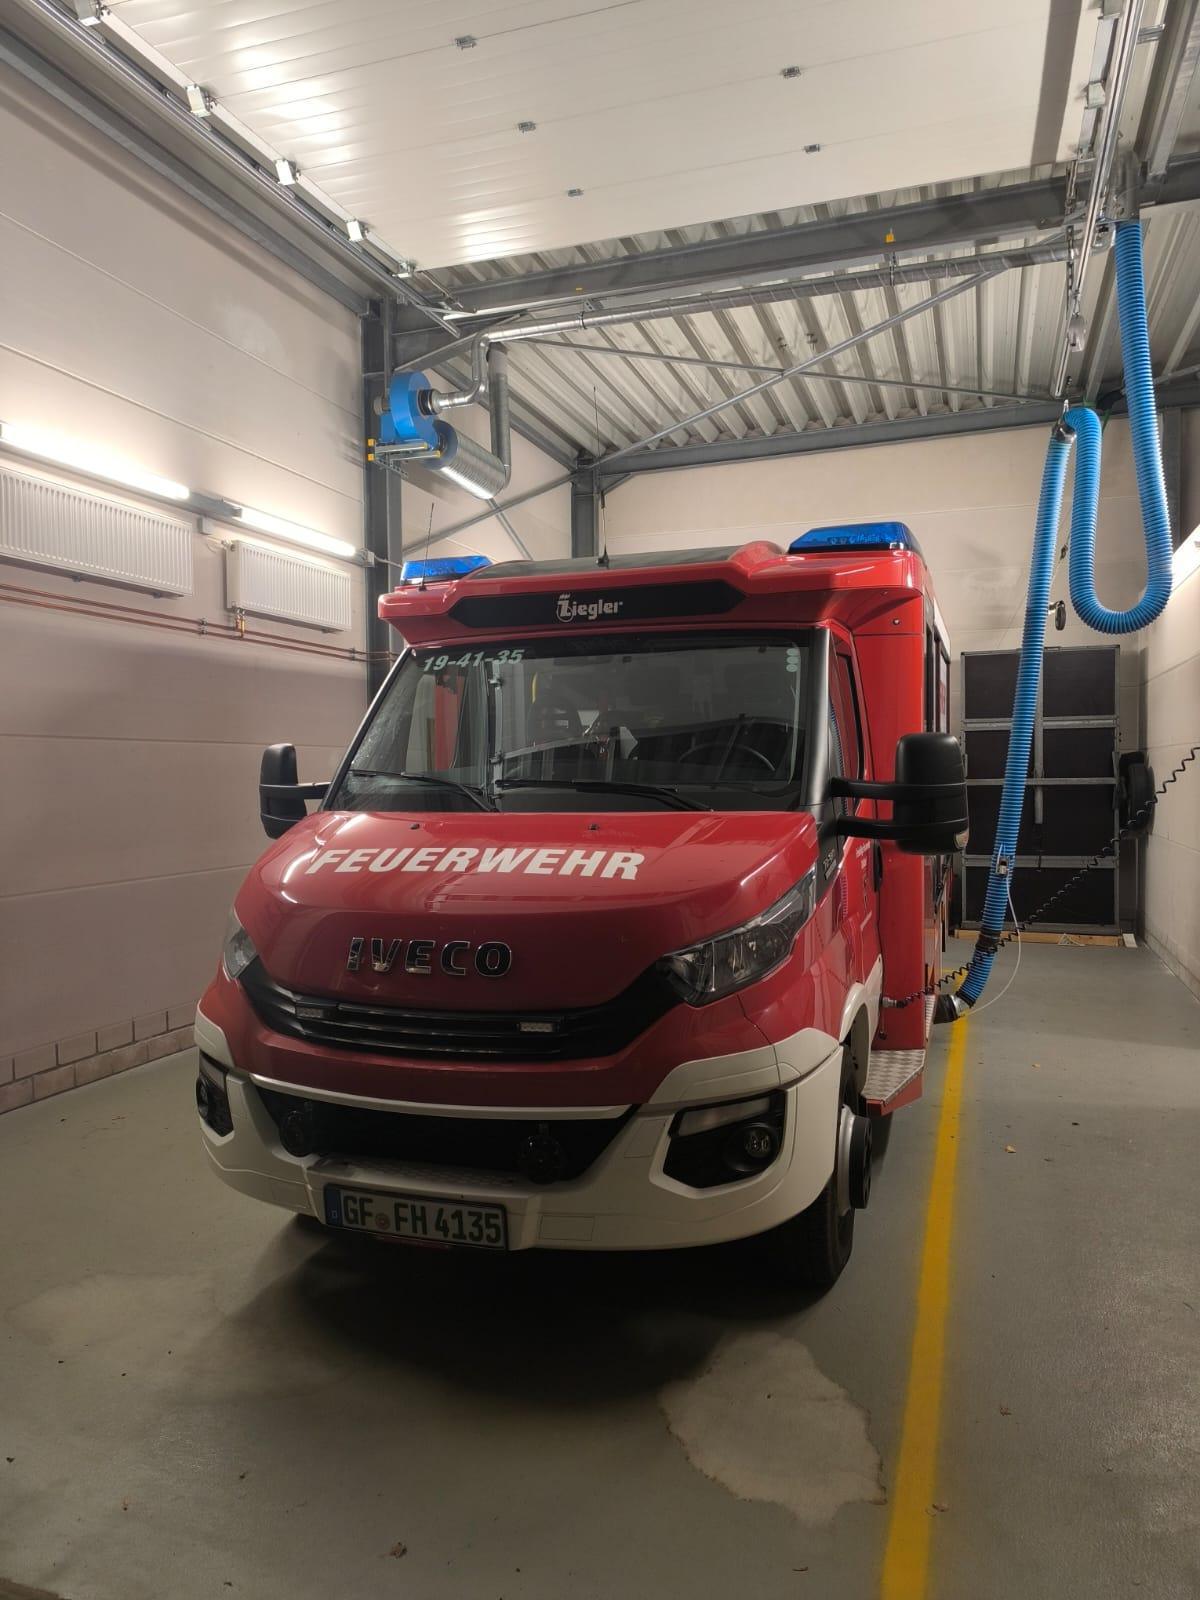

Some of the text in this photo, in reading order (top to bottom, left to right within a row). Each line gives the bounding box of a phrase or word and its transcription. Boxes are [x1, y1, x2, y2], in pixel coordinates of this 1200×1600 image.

[557, 595, 622, 622] Ziegler
[423, 649, 525, 672] 19-41-35
[306, 848, 645, 880] FEUERWEHR
[346, 937, 512, 977] IVECO
[343, 1194, 500, 1244] GF FH 4135
